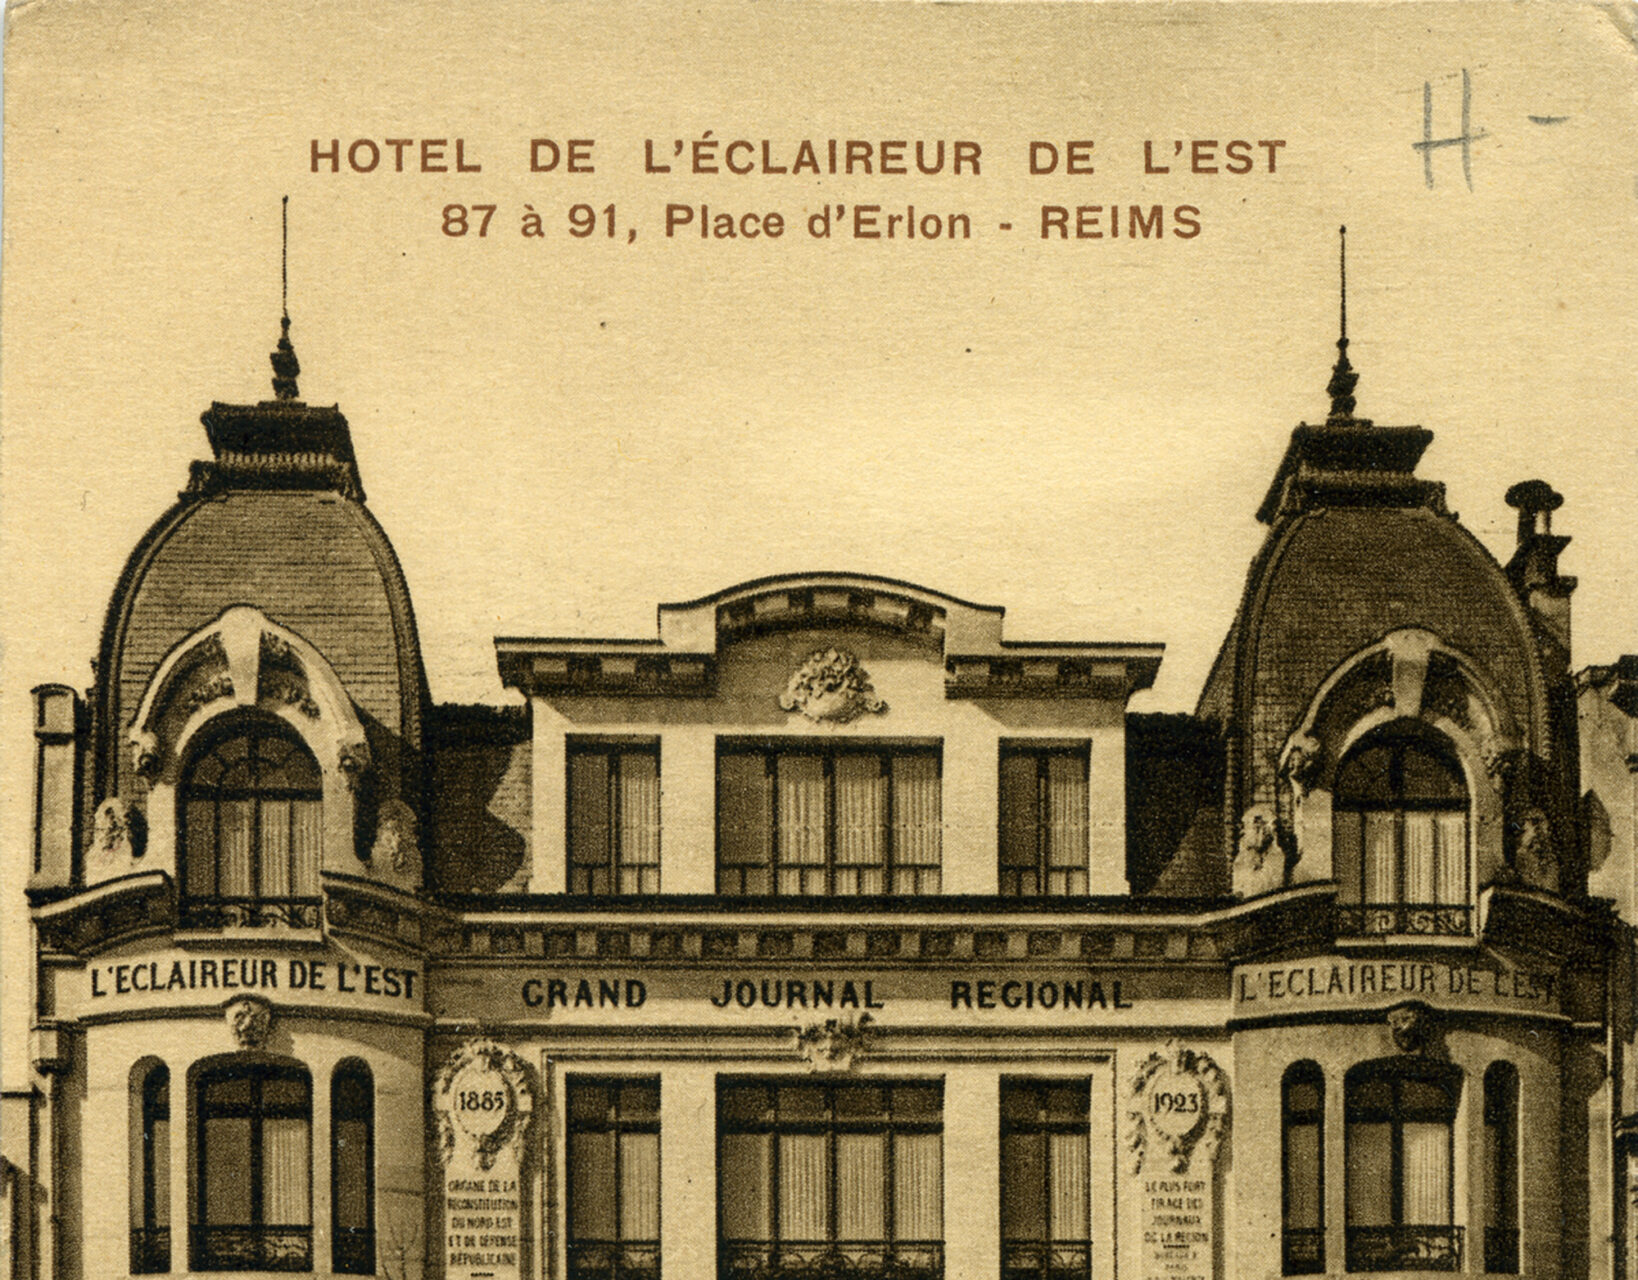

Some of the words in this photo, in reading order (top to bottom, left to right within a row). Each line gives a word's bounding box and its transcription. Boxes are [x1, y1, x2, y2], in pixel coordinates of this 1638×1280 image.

[91, 959, 278, 998] L'ECLAIREUR
[288, 960, 326, 991] DE
[337, 961, 418, 999] L'EST
[521, 978, 647, 1008] GRAND
[709, 978, 886, 1010] JOURNAL
[950, 979, 1134, 1011] REGIONAL
[1239, 964, 1437, 1001] L'ECLAIREUR
[1448, 964, 1482, 995] DE
[1494, 966, 1555, 1002] L'EST
[1154, 1092, 1199, 1114] 1923
